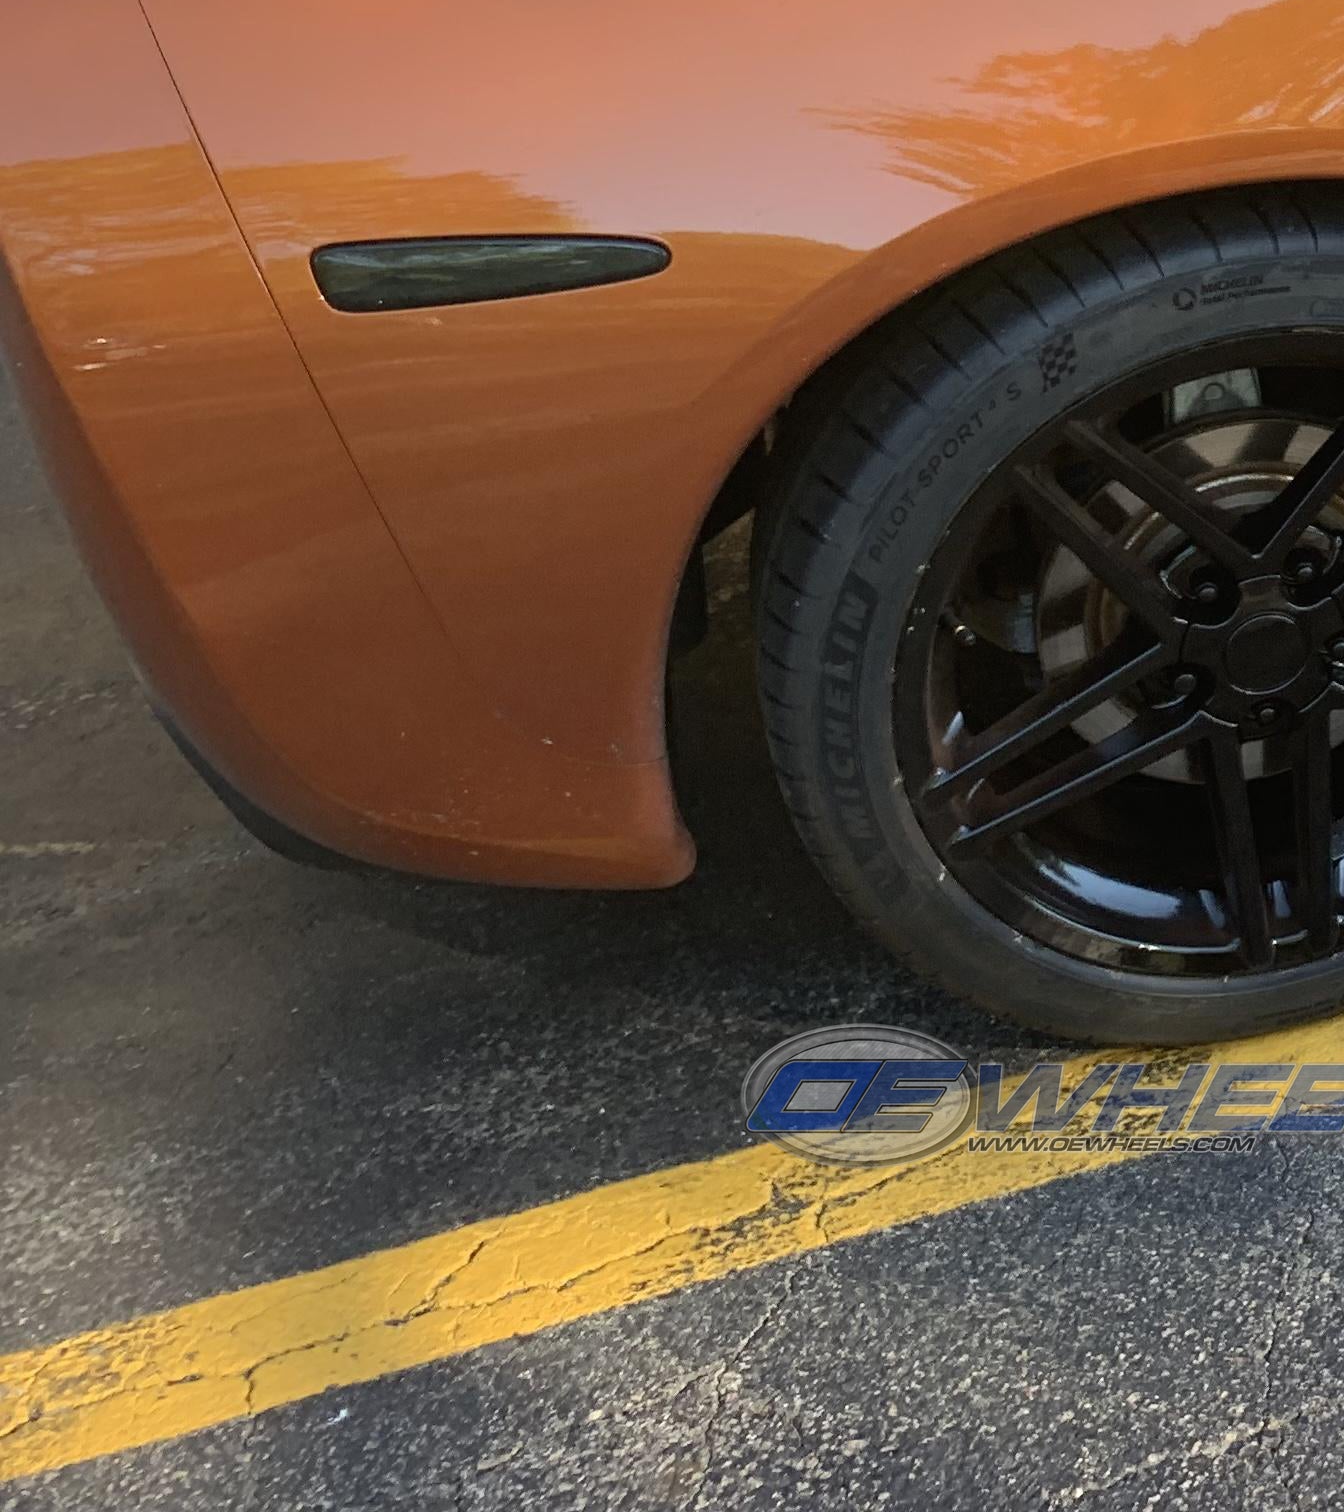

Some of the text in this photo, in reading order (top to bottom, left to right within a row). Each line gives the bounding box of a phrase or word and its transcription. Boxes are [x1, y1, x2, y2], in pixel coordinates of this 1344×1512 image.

[867, 487, 916, 564] PILOT
[917, 408, 985, 488] SPORT
[823, 589, 875, 839] MICHELIN
